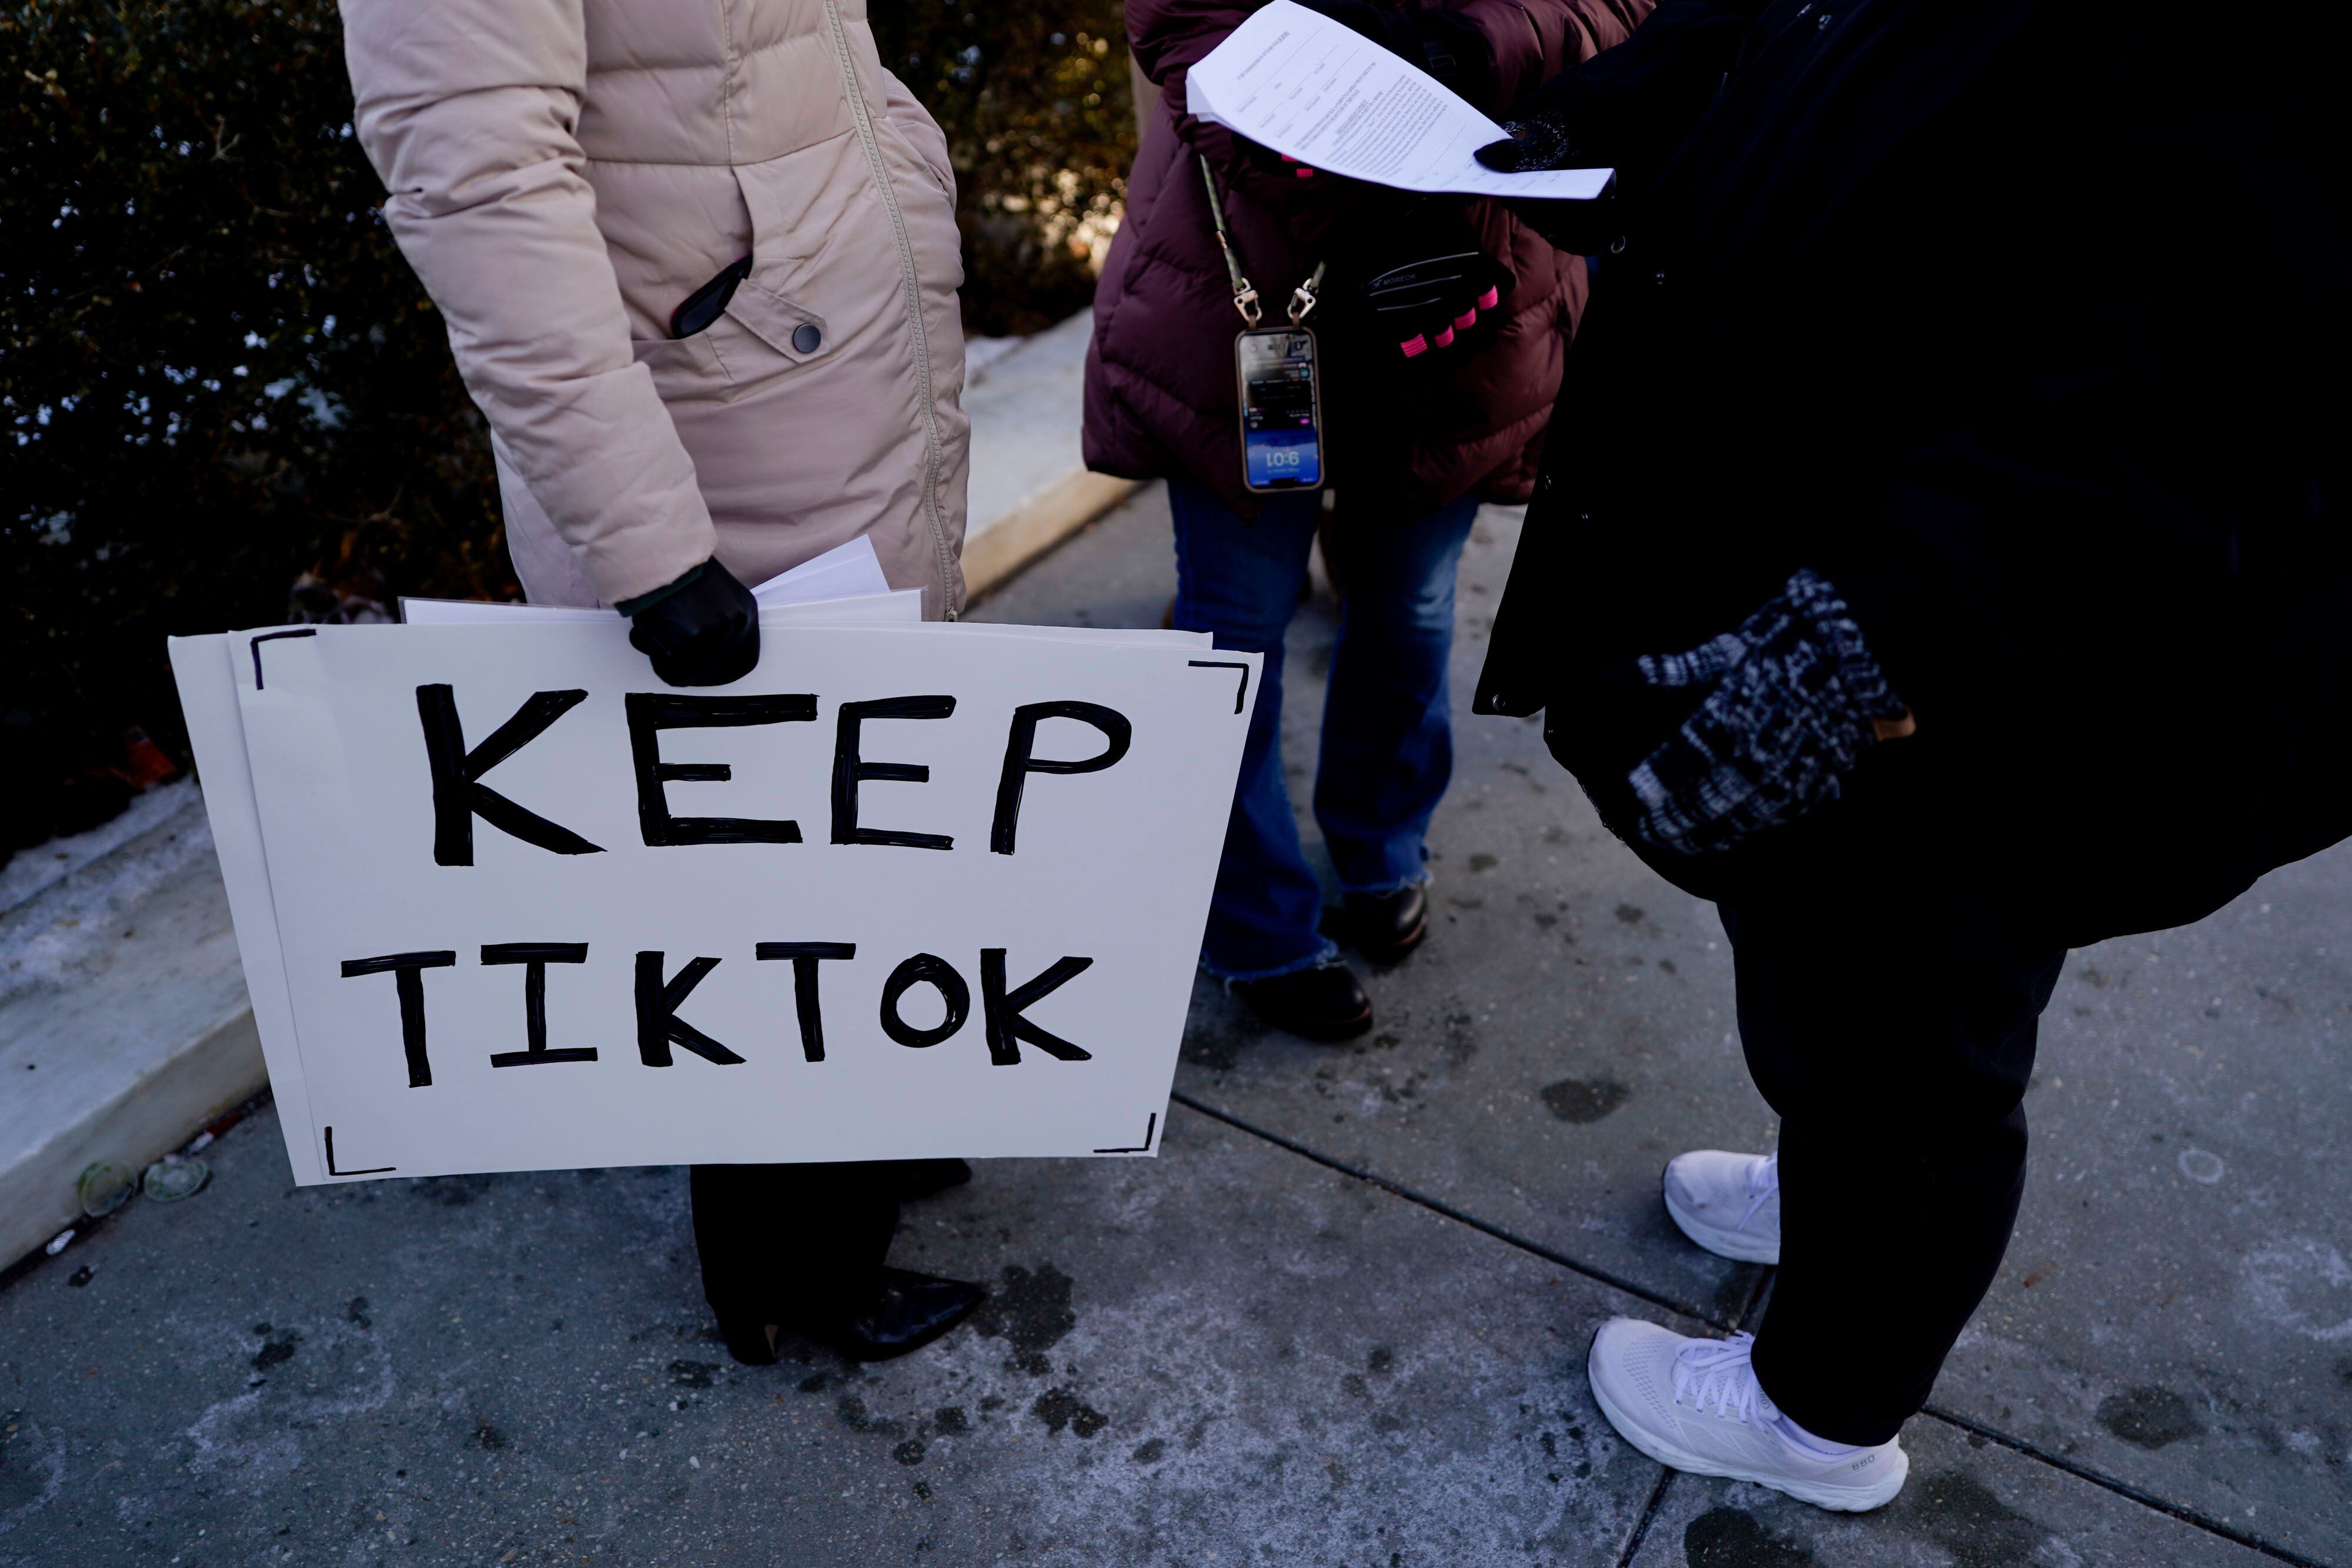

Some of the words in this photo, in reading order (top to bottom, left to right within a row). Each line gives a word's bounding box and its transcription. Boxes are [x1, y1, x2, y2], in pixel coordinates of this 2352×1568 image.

[1382, 273, 1416, 285] MOREOK
[1266, 451, 1299, 467] 9:01
[416, 684, 1131, 866] KEEP
[341, 942, 1094, 1088] TIKTOK
[1852, 1454, 1875, 1470] 880
